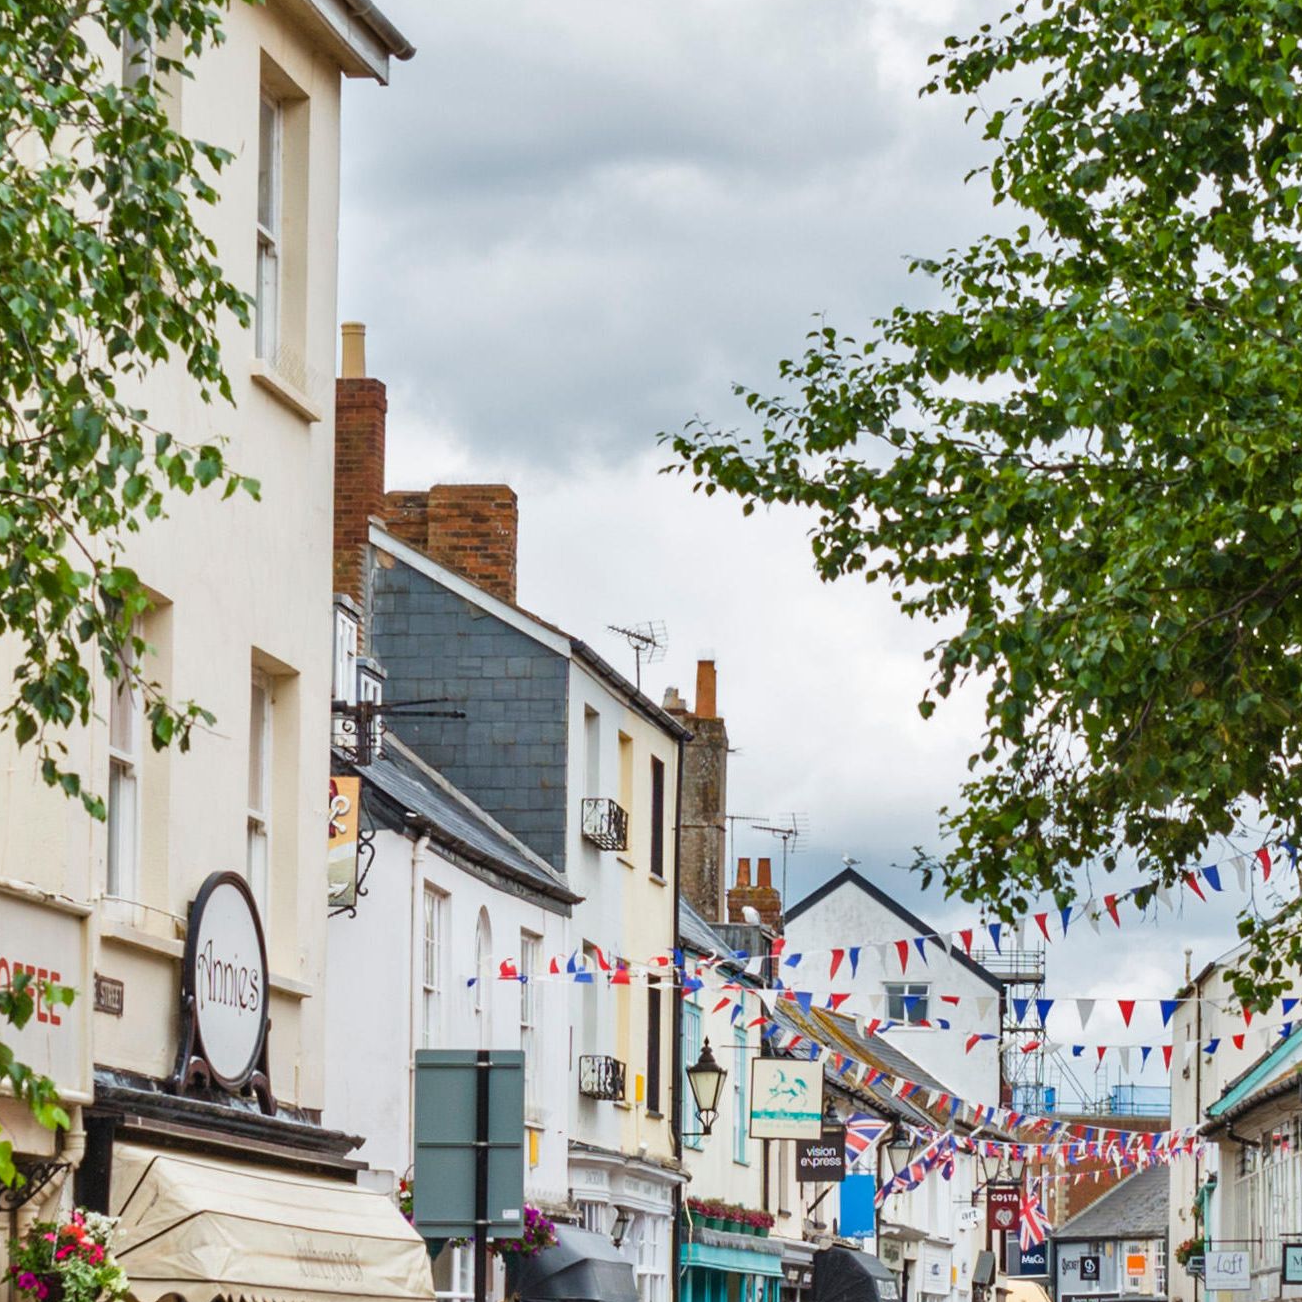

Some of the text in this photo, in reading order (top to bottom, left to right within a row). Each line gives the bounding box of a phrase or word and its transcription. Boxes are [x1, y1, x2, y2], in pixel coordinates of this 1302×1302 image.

[198, 939, 259, 1016] Annies
[806, 1146, 836, 1157] vision
[801, 1156, 841, 1169] express
[991, 1193, 1019, 1202] COSTA
[961, 1210, 978, 1221] art
